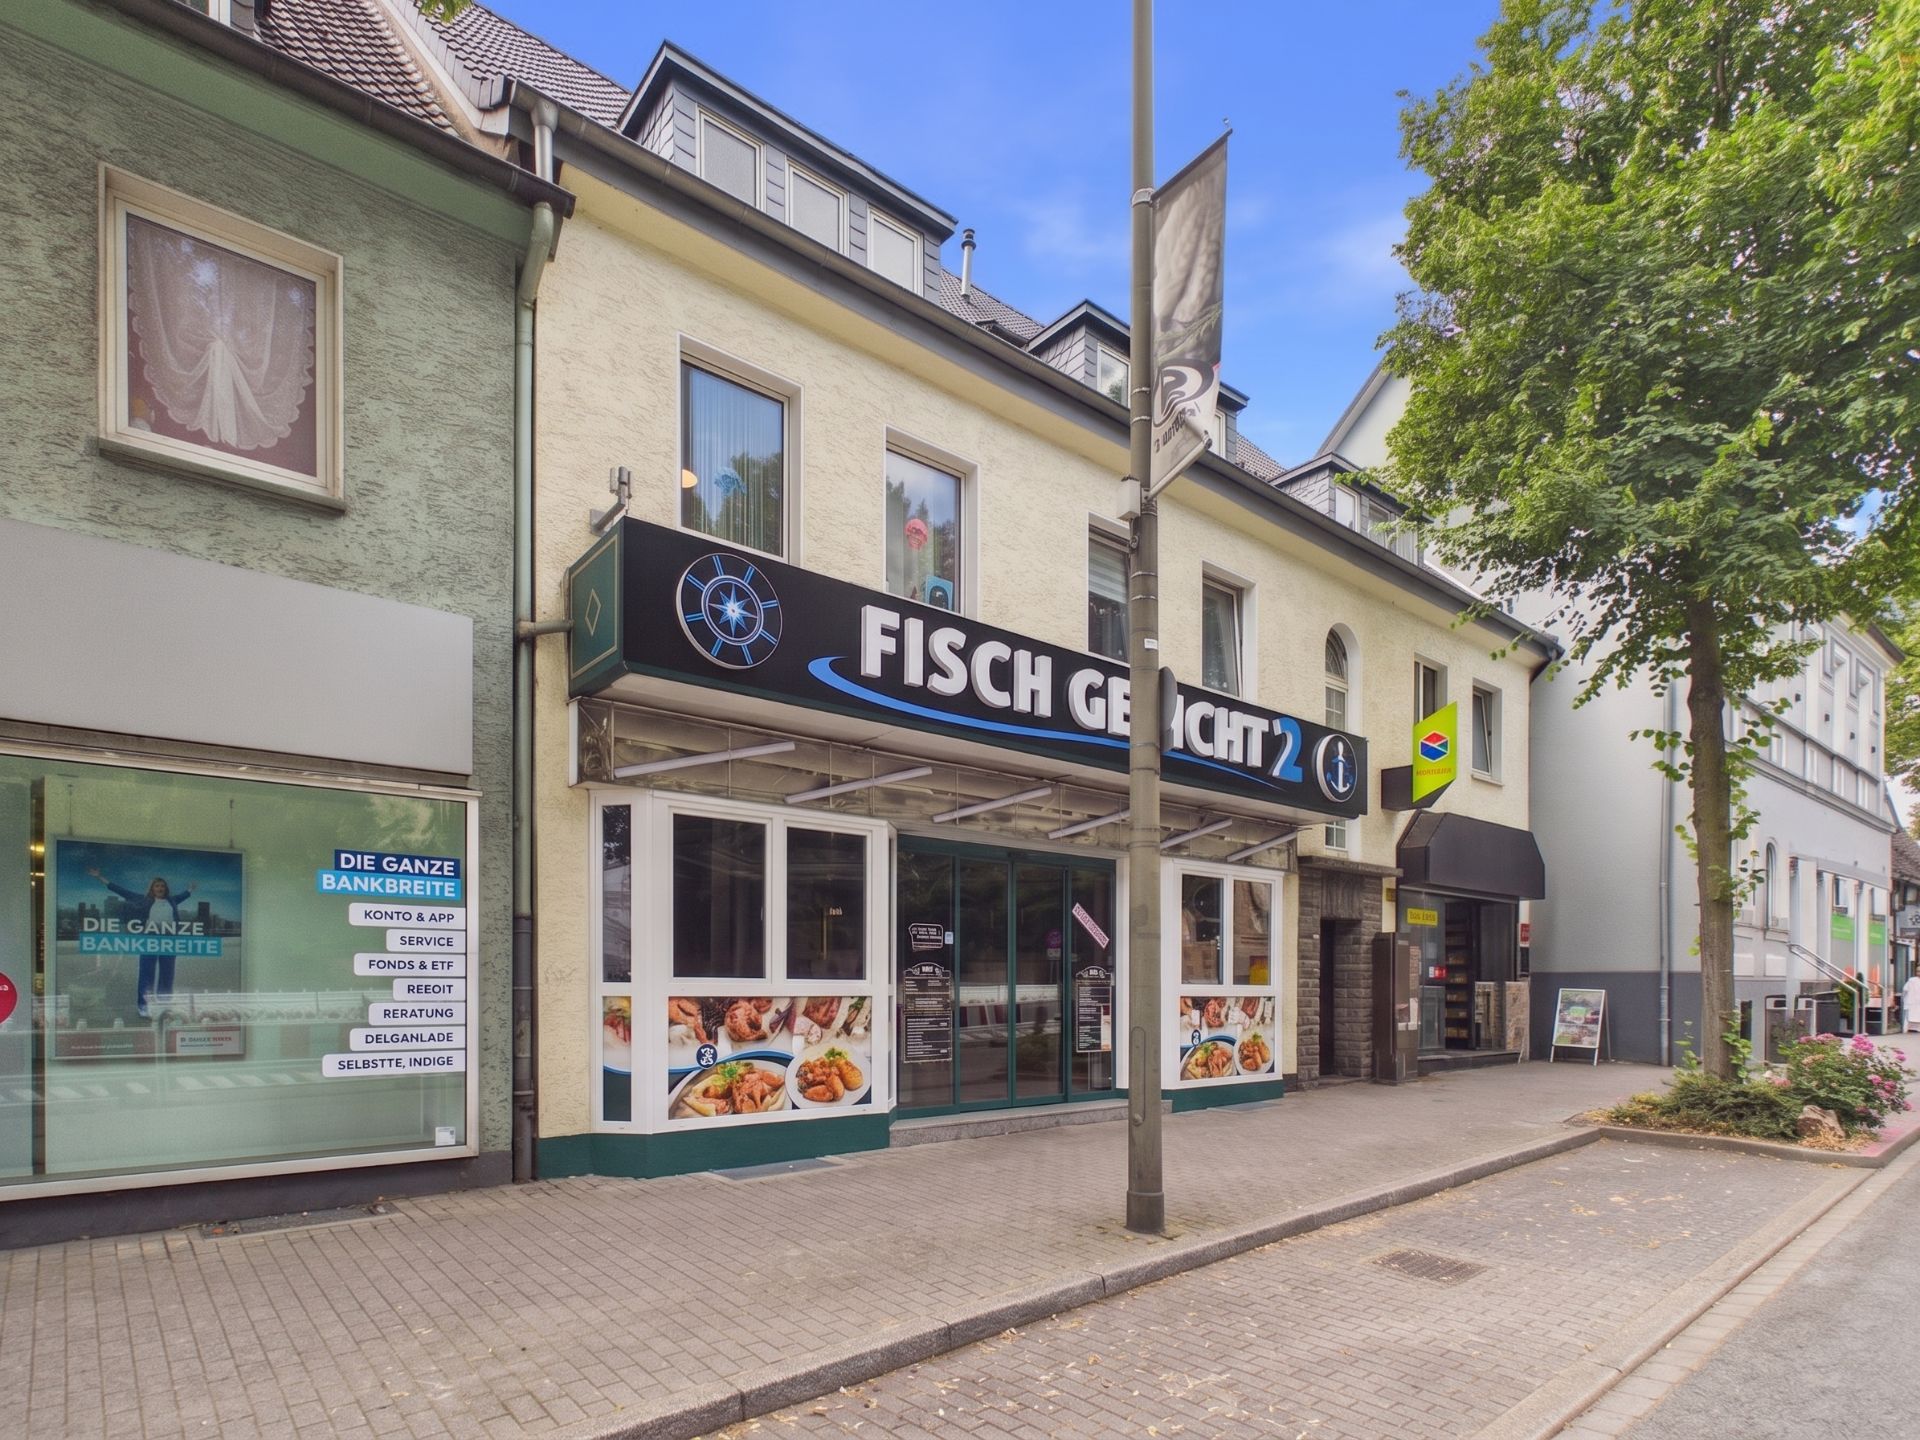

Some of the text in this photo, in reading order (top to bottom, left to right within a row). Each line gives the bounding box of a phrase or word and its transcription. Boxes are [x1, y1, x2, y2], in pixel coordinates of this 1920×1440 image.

[860, 604, 1052, 719] FISCH
[1068, 668, 1269, 768] GEICHT
[340, 853, 455, 876] DIE GANZE
[322, 873, 456, 897] BANKBREITE
[364, 909, 455, 923] KONTO & APP
[83, 917, 204, 936] DIE GANZE
[82, 936, 219, 954] BANKBREITE
[399, 935, 454, 947] SERVICE
[368, 959, 454, 970] FONDS & ETF
[409, 1056, 454, 1068] INDIGE
